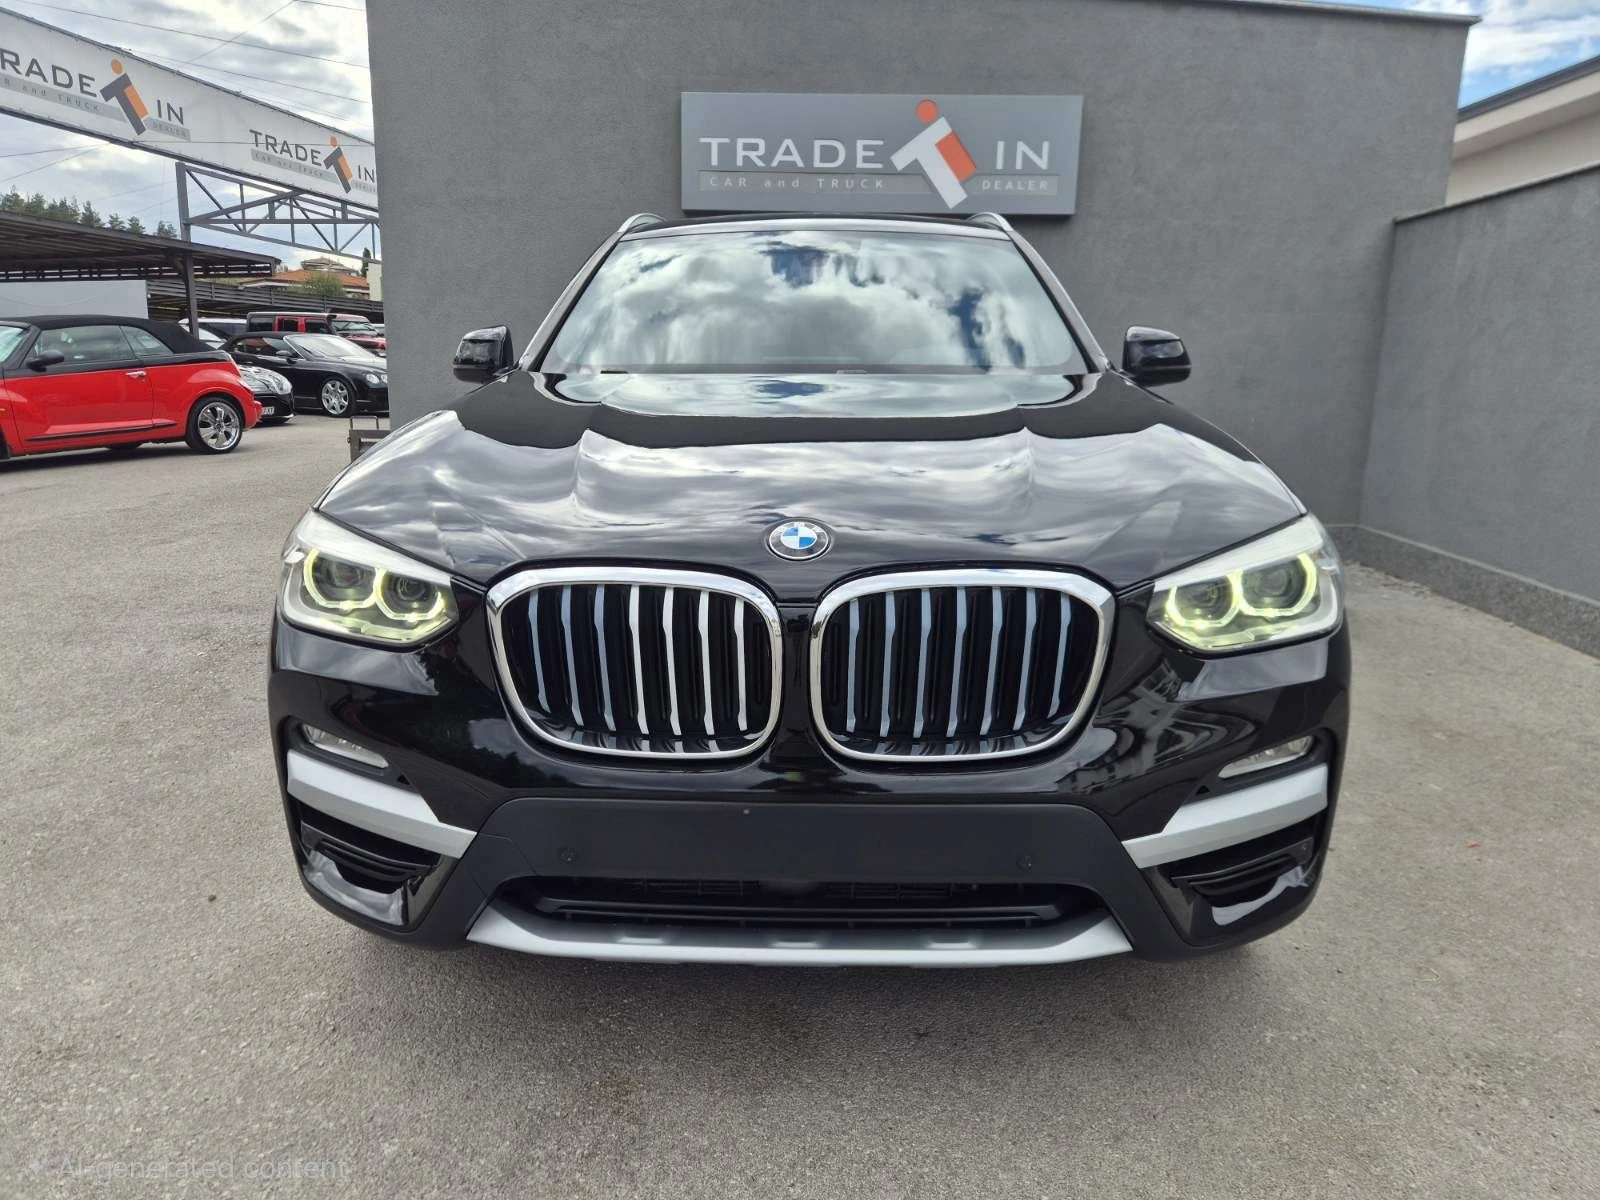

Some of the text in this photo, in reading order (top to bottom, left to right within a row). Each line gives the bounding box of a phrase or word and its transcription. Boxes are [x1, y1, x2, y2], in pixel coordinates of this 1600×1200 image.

[157, 99, 184, 126] IN
[249, 128, 323, 167] TRADE
[358, 164, 375, 184] IN
[699, 137, 1050, 170] TRADE IN
[710, 176, 1049, 191] CAR and TRUCK DEALER
